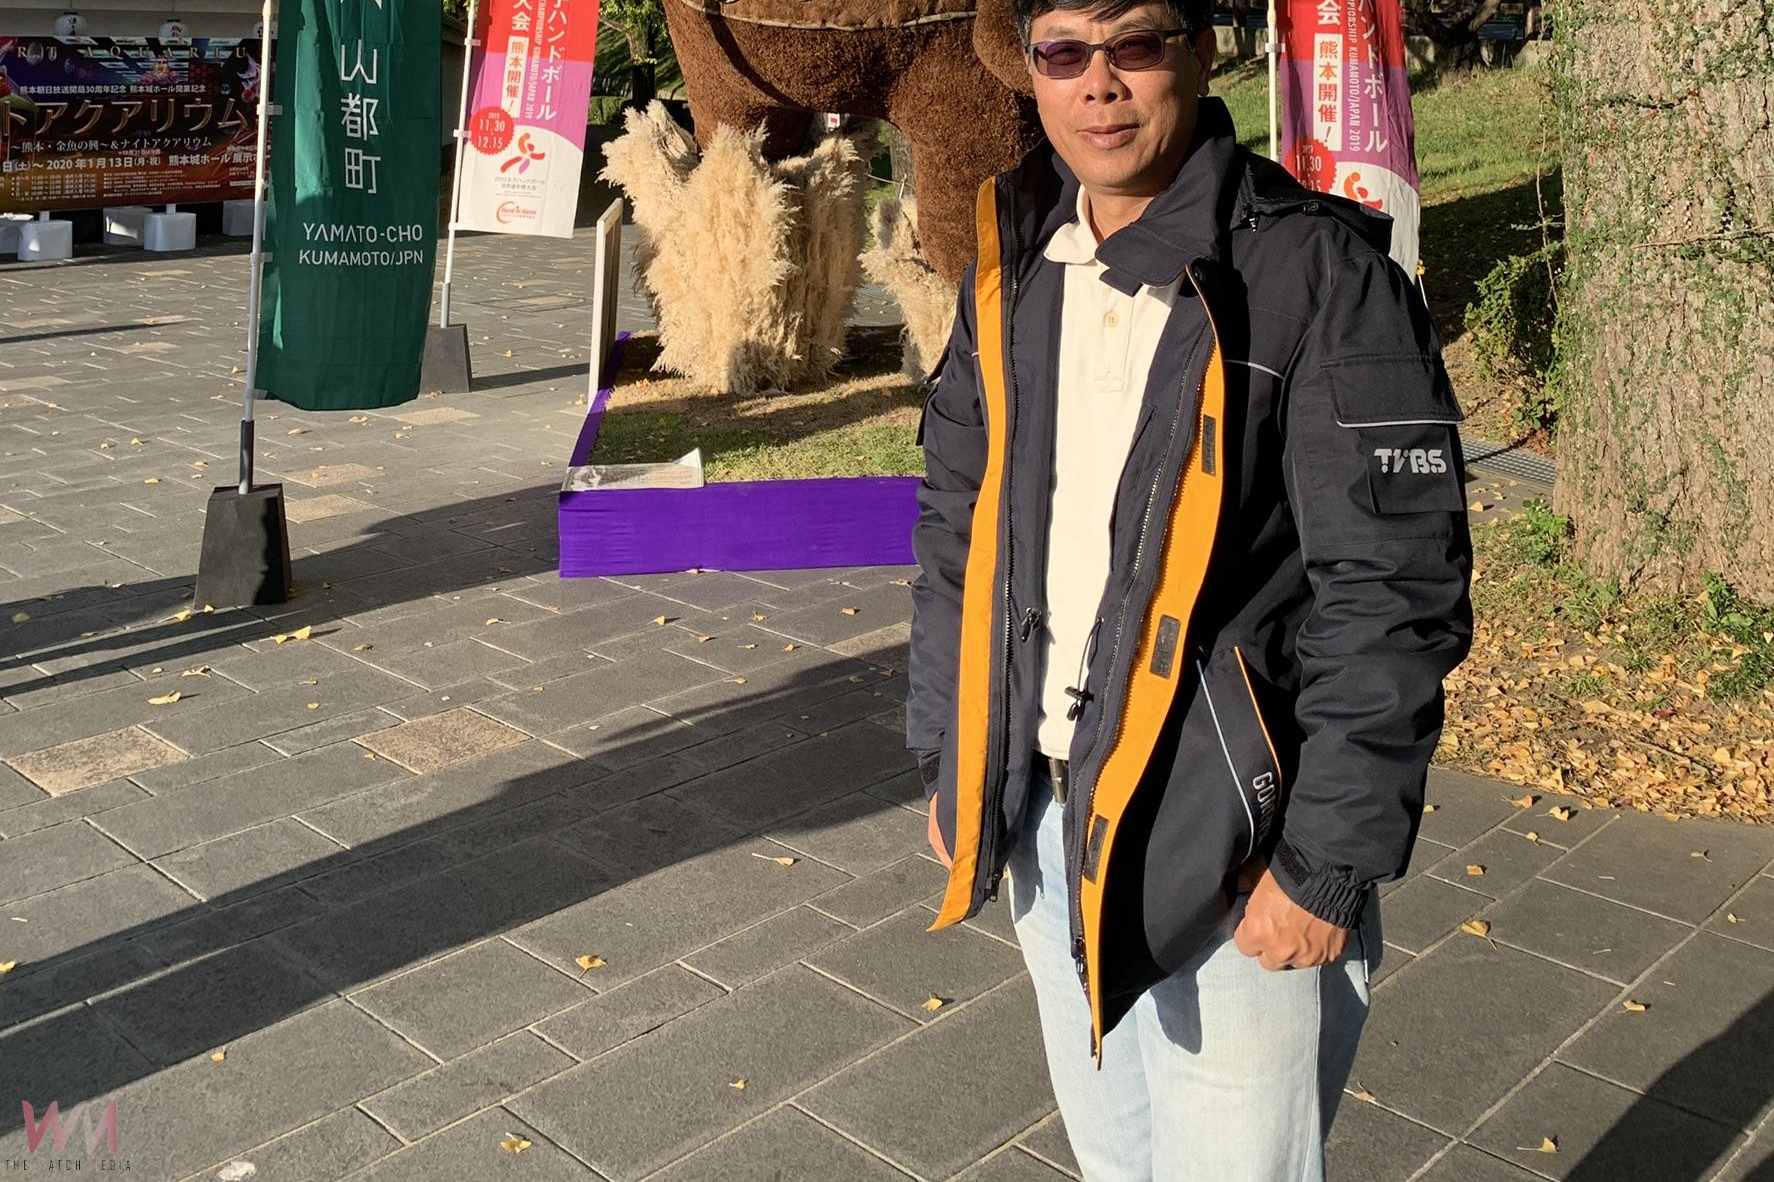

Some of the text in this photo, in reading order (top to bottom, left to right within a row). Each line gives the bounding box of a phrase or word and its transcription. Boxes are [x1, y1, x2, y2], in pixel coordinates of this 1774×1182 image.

[1318, 40, 1338, 143] 熊本開催!
[1348, 46, 1360, 125] KUMAMOTO/JAPAN
[341, 39, 381, 194] 山都町
[478, 136, 503, 149] 12.15
[1349, 129, 1360, 151] 2019
[303, 222, 423, 242] YAMATO-CHO
[299, 249, 423, 266] KUMAMOTO/JPN
[1374, 449, 1447, 474] TVBS
